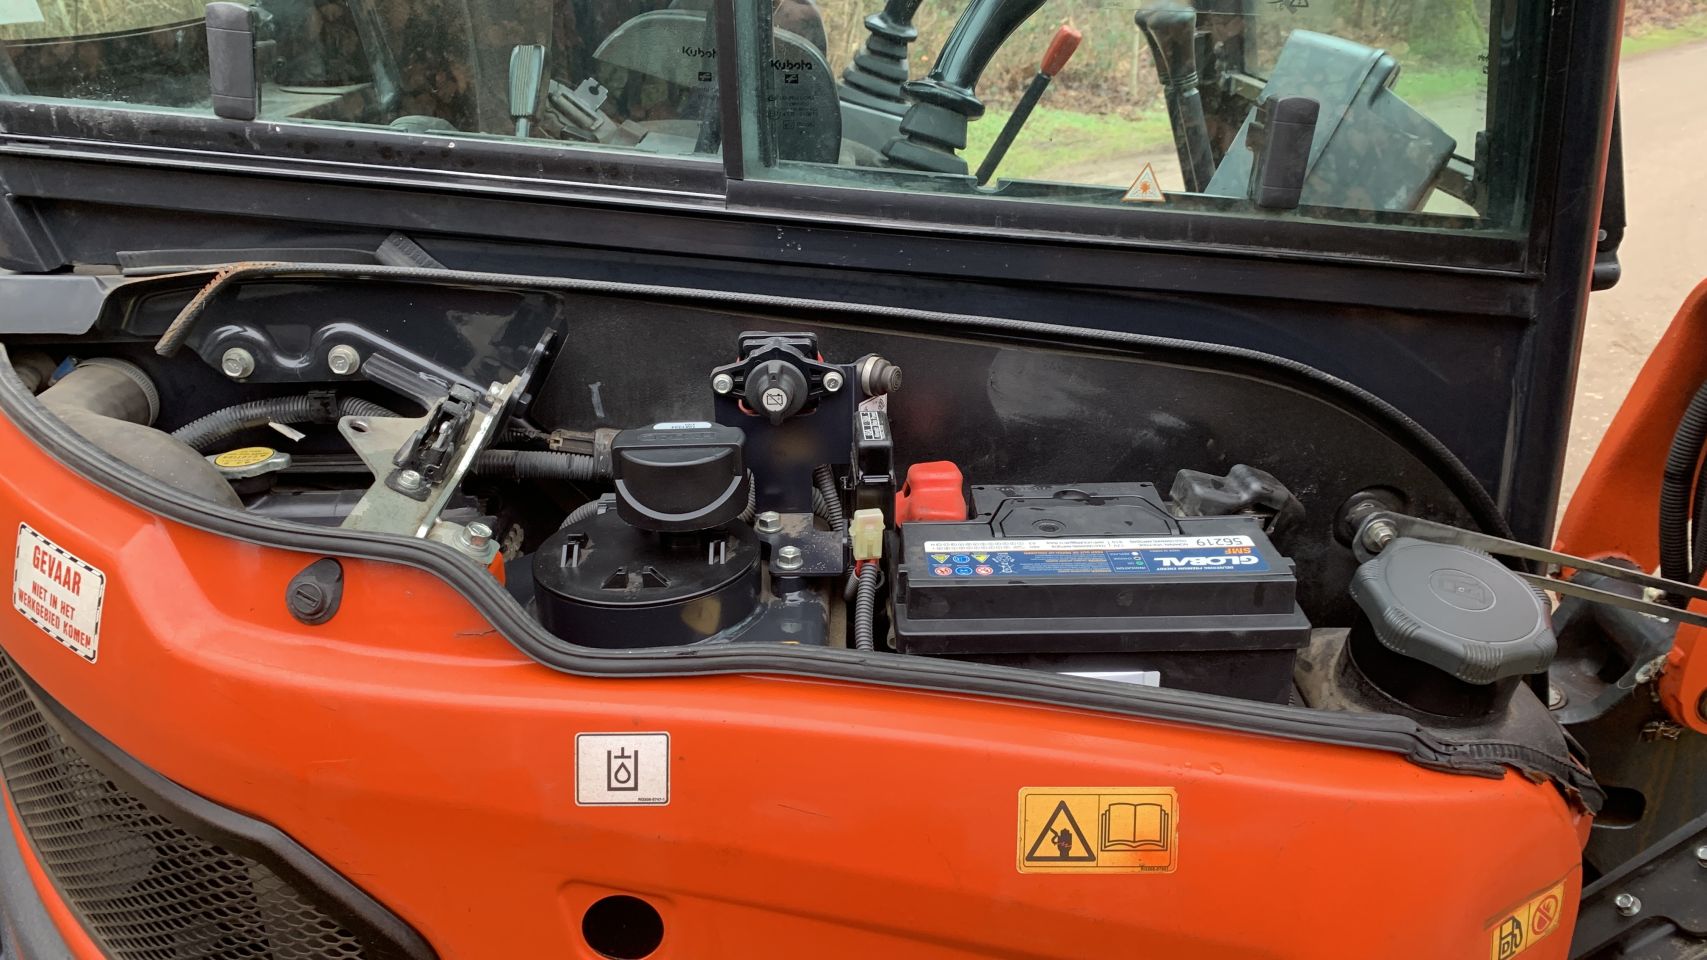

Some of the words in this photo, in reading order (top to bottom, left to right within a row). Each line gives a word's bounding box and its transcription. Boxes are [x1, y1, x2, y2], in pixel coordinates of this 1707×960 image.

[682, 46, 717, 58] Kubot
[771, 59, 812, 71] Kubota
[1196, 537, 1243, 547] 56219
[1224, 547, 1252, 555] SMF
[1153, 555, 1259, 567] GLOBAL
[32, 545, 82, 596] GEVAAR
[31, 581, 48, 602] NIET
[49, 593, 58, 610] IN
[60, 600, 76, 620] HET
[17, 588, 61, 630] WERKGEBIED
[63, 621, 91, 650] KOMEN
